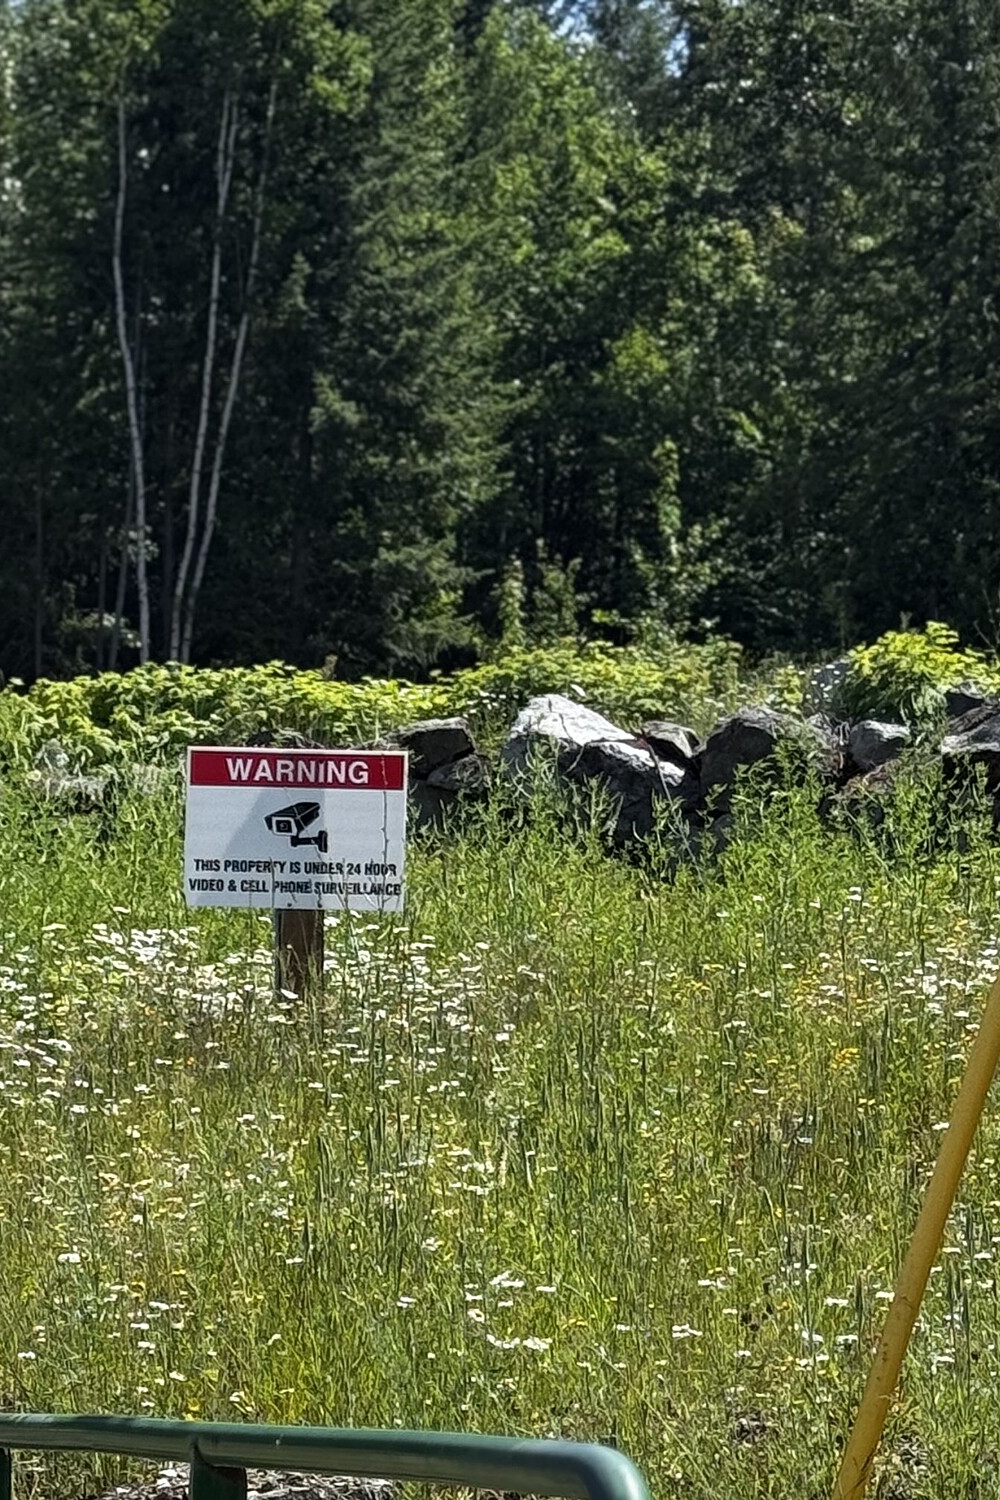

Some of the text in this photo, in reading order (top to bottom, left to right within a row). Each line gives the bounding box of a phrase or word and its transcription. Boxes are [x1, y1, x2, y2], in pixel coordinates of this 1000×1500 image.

[225, 757, 369, 784] WARNING
[194, 858, 220, 873] THIS
[290, 861, 301, 874] IS
[304, 861, 344, 875] UNDER
[346, 862, 361, 876] 24
[364, 863, 397, 876] HOUR
[188, 878, 401, 896] VIDEO & CELL PHONE SURVEILLANCE
